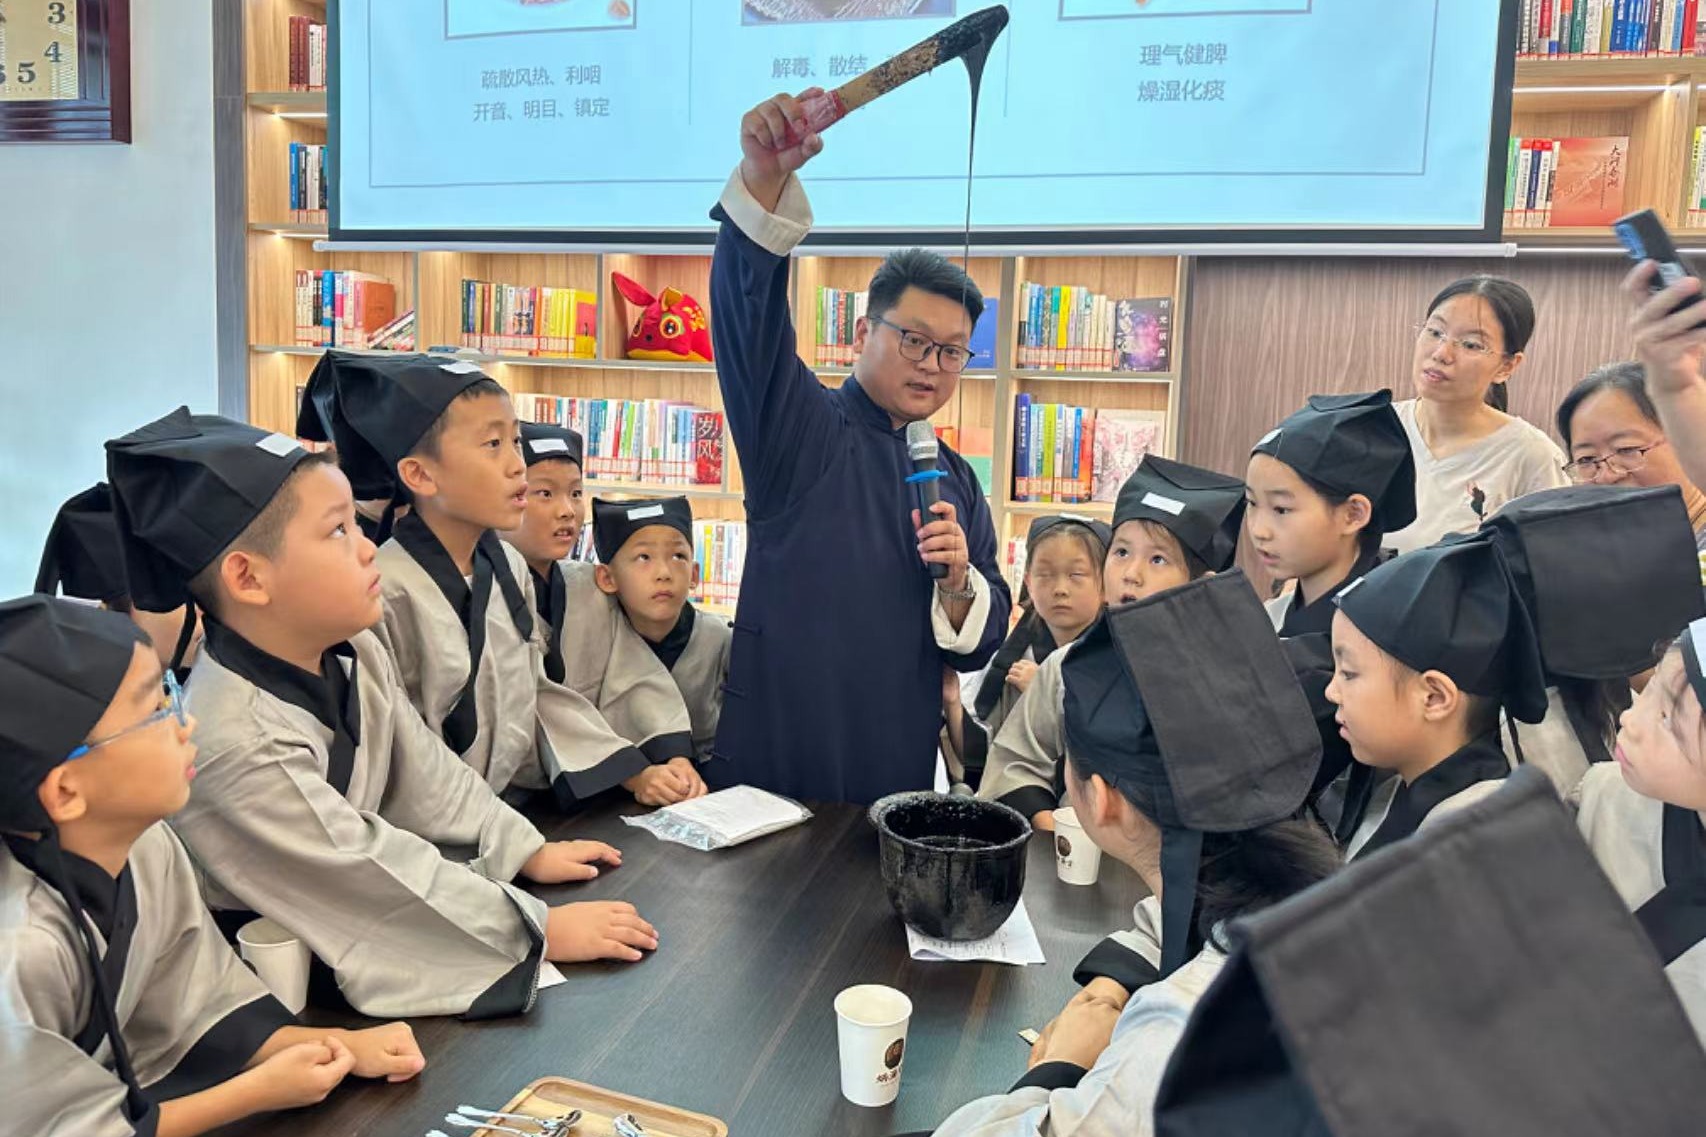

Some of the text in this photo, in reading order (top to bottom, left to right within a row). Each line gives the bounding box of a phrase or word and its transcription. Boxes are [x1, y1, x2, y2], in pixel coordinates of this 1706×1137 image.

[48, 2, 66, 24] 3
[44, 41, 63, 63] 4
[1139, 43, 1228, 66] 理气健脾
[17, 61, 36, 84] 5
[481, 65, 602, 89] 疏散风热、利咽
[1137, 79, 1226, 102] 燥湿化痰
[473, 97, 610, 122] 开音、明目、镇定
